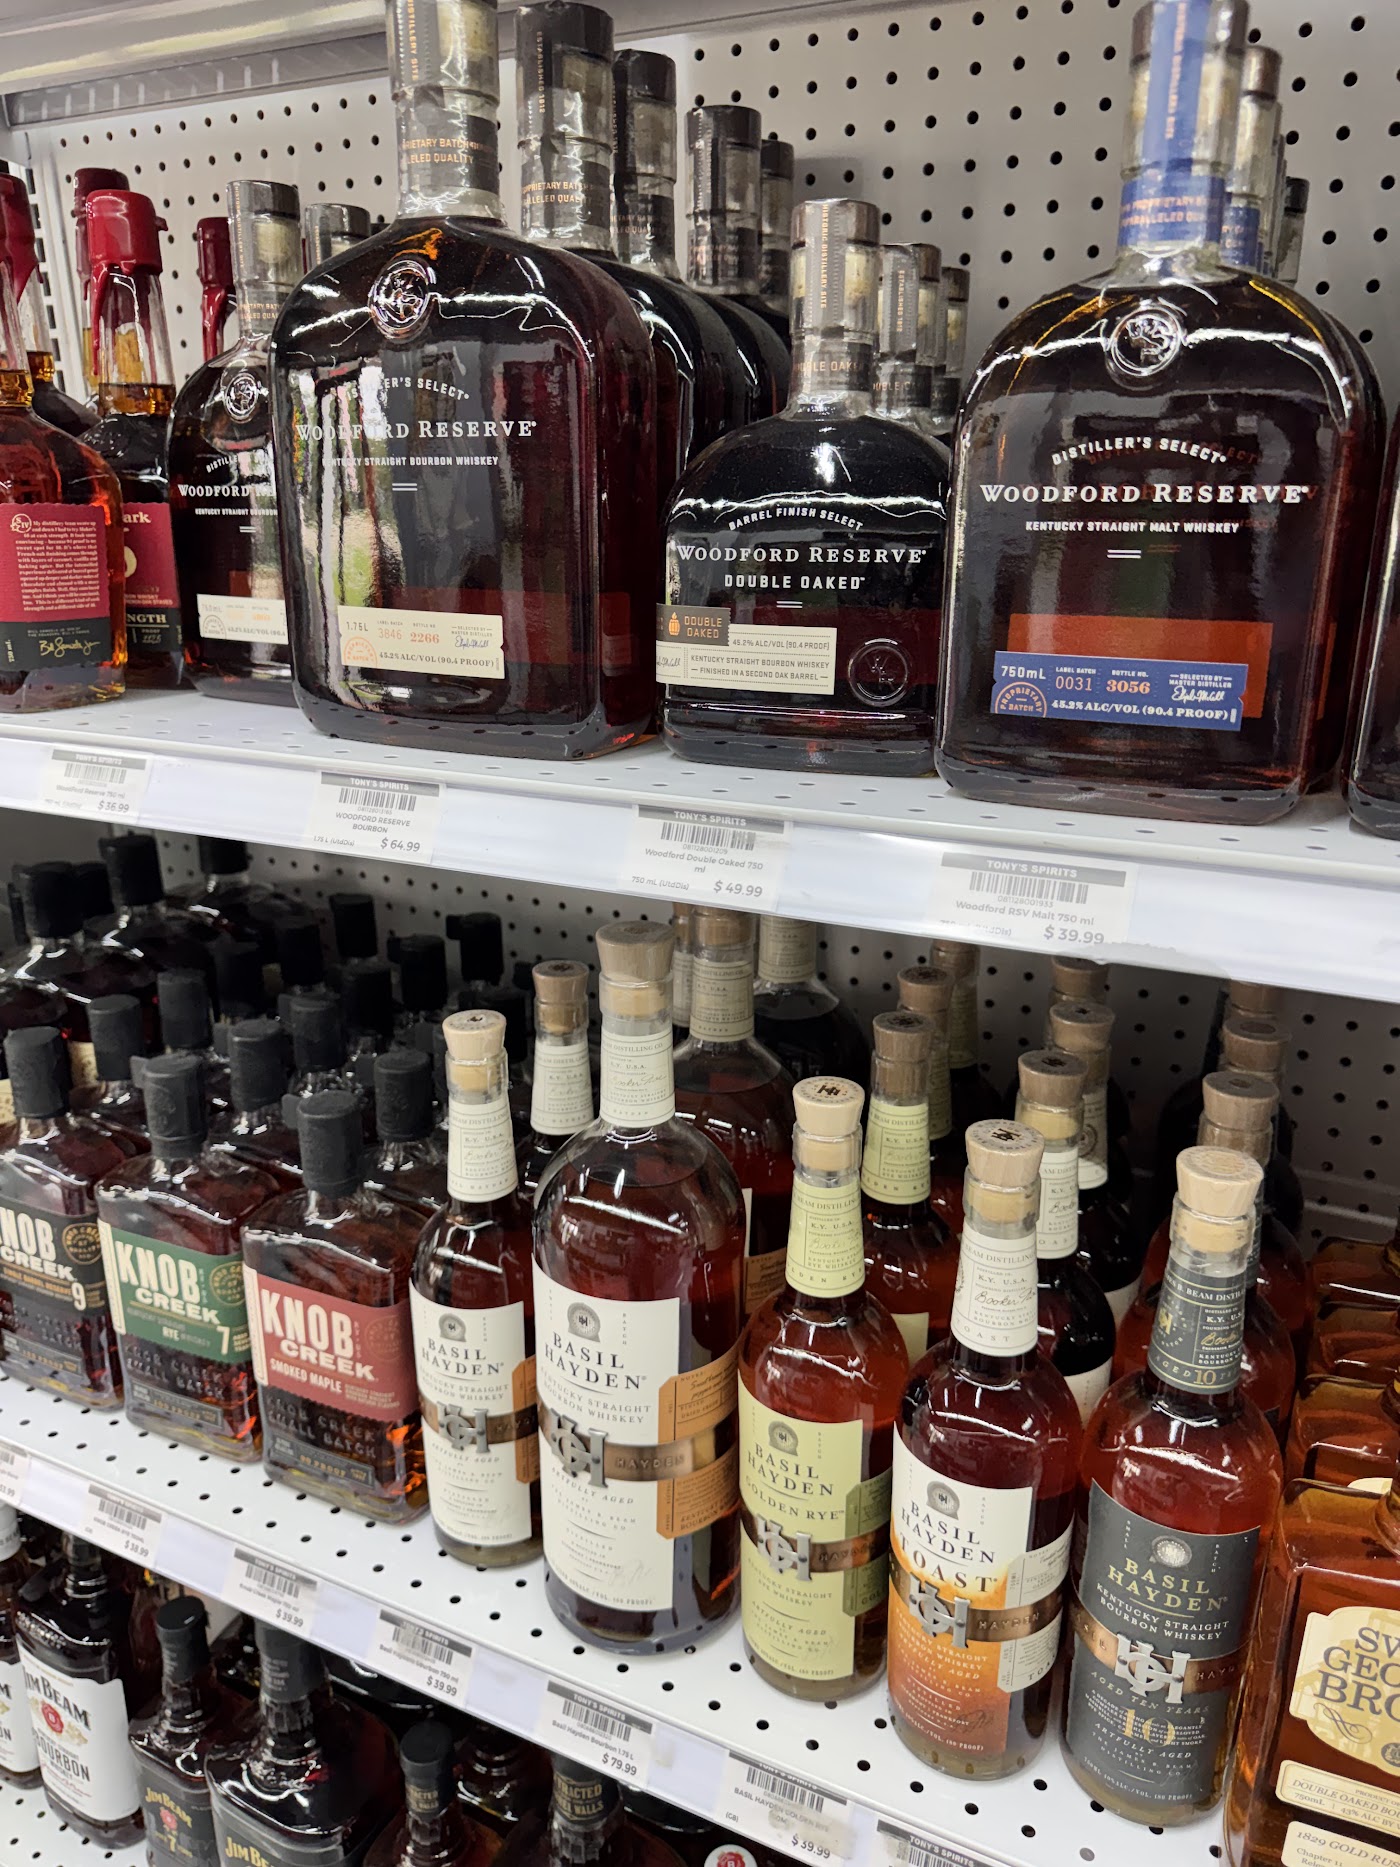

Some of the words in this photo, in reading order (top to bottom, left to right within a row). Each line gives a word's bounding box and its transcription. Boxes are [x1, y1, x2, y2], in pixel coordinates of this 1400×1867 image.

[417, 378, 465, 400] SELECT
[418, 420, 533, 438] RESERVE
[1051, 437, 1152, 466] DISTILLER'S
[1158, 437, 1221, 464] SELECT
[365, 457, 406, 465] STRAIGHT
[410, 457, 452, 465] BOURBON
[456, 457, 502, 465] WHISKEY
[178, 484, 250, 497] WOODFORD
[980, 484, 1141, 503] WOODFORD
[1153, 483, 1302, 503] RESERVE
[123, 511, 151, 524] ark
[729, 510, 772, 531] BARREL
[776, 507, 816, 518] FINISH
[820, 510, 863, 531] SELECT
[1025, 521, 1084, 532] KENTUCKY
[1087, 522, 1145, 532] STRAIGHT
[1149, 522, 1180, 533] MALT
[1183, 522, 1239, 533] WHISKEY
[677, 545, 800, 562] WOODFORD
[809, 547, 922, 564] RESERVE
[724, 574, 792, 589] DOUBLE
[800, 576, 860, 590] OAKED
[346, 621, 368, 632] 1.75L
[684, 616, 722, 627] DOUBLE
[378, 628, 402, 640] 3846
[410, 632, 440, 644] 2266
[687, 628, 719, 639] OAKED
[733, 639, 754, 647] 45.2%
[401, 654, 436, 663] ALC/VOL
[460, 658, 494, 667] PROOF)
[691, 655, 725, 664] KENTUCKY
[726, 657, 759, 666] STRAIGHT
[762, 659, 795, 667] BOURBON
[797, 660, 830, 669] WHISKEY
[700, 667, 730, 676] FINISHED
[746, 670, 772, 678] SECOND
[775, 671, 788, 679] OAK
[790, 672, 818, 680] BARREL
[1001, 665, 1047, 680] 750mL
[1055, 676, 1093, 692] 0031
[1106, 679, 1151, 694] 3056
[1197, 680, 1232, 688] DISTILLER
[1008, 704, 1034, 712] BATCH
[1086, 702, 1140, 714] ALC/VOL
[1142, 706, 1173, 716] (90.4
[1176, 708, 1229, 721] PROOF)
[350, 778, 377, 787] TONY'S
[379, 781, 409, 790] SPIRITS
[105, 802, 129, 813] 36.99
[336, 812, 377, 823] WOODFORD
[378, 817, 411, 827] RESERVE
[674, 810, 707, 822] TONY'S
[710, 815, 746, 827] SPIRITS
[352, 824, 388, 833] BOURBON
[390, 840, 420, 852] 64.99
[645, 848, 685, 861] Woodford
[686, 853, 716, 864] Double
[718, 858, 745, 868] Oaked
[747, 861, 763, 870] 750
[986, 859, 1028, 872] TONY'S
[1030, 865, 1078, 878] SPIRITS
[725, 882, 763, 898] 49.99
[956, 901, 1006, 914] Woodford
[1008, 907, 1030, 917] RSV
[1032, 912, 1055, 921] Malt
[1057, 913, 1077, 924] 750
[1079, 917, 1095, 926] ml
[1058, 927, 1105, 945] 39.99
[0, 1207, 56, 1261] NOB
[0, 1246, 75, 1281] CREEK
[115, 1241, 201, 1304] KNOB
[71, 1282, 86, 1310] 9
[1187, 1289, 1213, 1300] BEAM
[135, 1288, 220, 1324] CREEK
[261, 1289, 354, 1359] KNOB
[162, 1326, 179, 1341] RYE
[216, 1325, 230, 1355] 7
[428, 1337, 486, 1360] BASIL
[553, 1331, 624, 1369] BASIL
[280, 1339, 375, 1381] CREEK
[422, 1347, 499, 1375] HAYDEN
[545, 1343, 641, 1390] HAYDEN
[270, 1358, 307, 1383] SMOKED
[310, 1372, 342, 1393] MAPLE
[1194, 1370, 1216, 1385] 10
[588, 1398, 651, 1413] STRAIGHT
[588, 1409, 644, 1423] WHISKEY
[755, 1442, 819, 1479] BASIL
[748, 1451, 833, 1496] HAYDEN
[806, 1510, 839, 1520] RYE
[911, 1500, 980, 1545] BASIL
[901, 1507, 996, 1564] HAYDEN
[900, 1531, 993, 1593] TOAST
[1124, 1557, 1210, 1594] BASIL
[1108, 1565, 1222, 1612] HAYDEN
[1096, 1583, 1160, 1624] KENTUCKY
[1165, 1620, 1229, 1632] STRAIGHT
[1100, 1596, 1158, 1633] BOURBON
[1164, 1629, 1222, 1641] WHISKEY
[937, 1644, 989, 1662] STRAIGHT
[937, 1654, 982, 1671] WHISKEY
[433, 1680, 457, 1696] 39.99
[1091, 1671, 1124, 1696] AGED
[1131, 1695, 1159, 1710] TEN
[41, 1675, 92, 1731] BEAM
[573, 1694, 598, 1709] TONY'S
[552, 1719, 567, 1730] Basil
[567, 1726, 590, 1740] Hayden
[590, 1736, 617, 1752] Bourbon
[1095, 1722, 1154, 1755] ARTFULLY
[611, 1757, 637, 1775] 79.99
[734, 1787, 753, 1800] BASIL
[1292, 1779, 1338, 1800] DOUBLE
[1339, 1791, 1379, 1811] OAKED
[145, 1787, 162, 1803] JIM
[162, 1793, 192, 1828] BEAM
[1360, 1811, 1381, 1823] ALC
[1381, 1818, 1394, 1828] BY
[225, 1836, 249, 1861] JIM
[909, 1835, 940, 1856] TONY'S
[941, 1849, 975, 1867] SPIRITS
[1296, 1831, 1326, 1847] 1829
[1328, 1840, 1371, 1860] GOLD
[1296, 1847, 1333, 1864] Chapter
